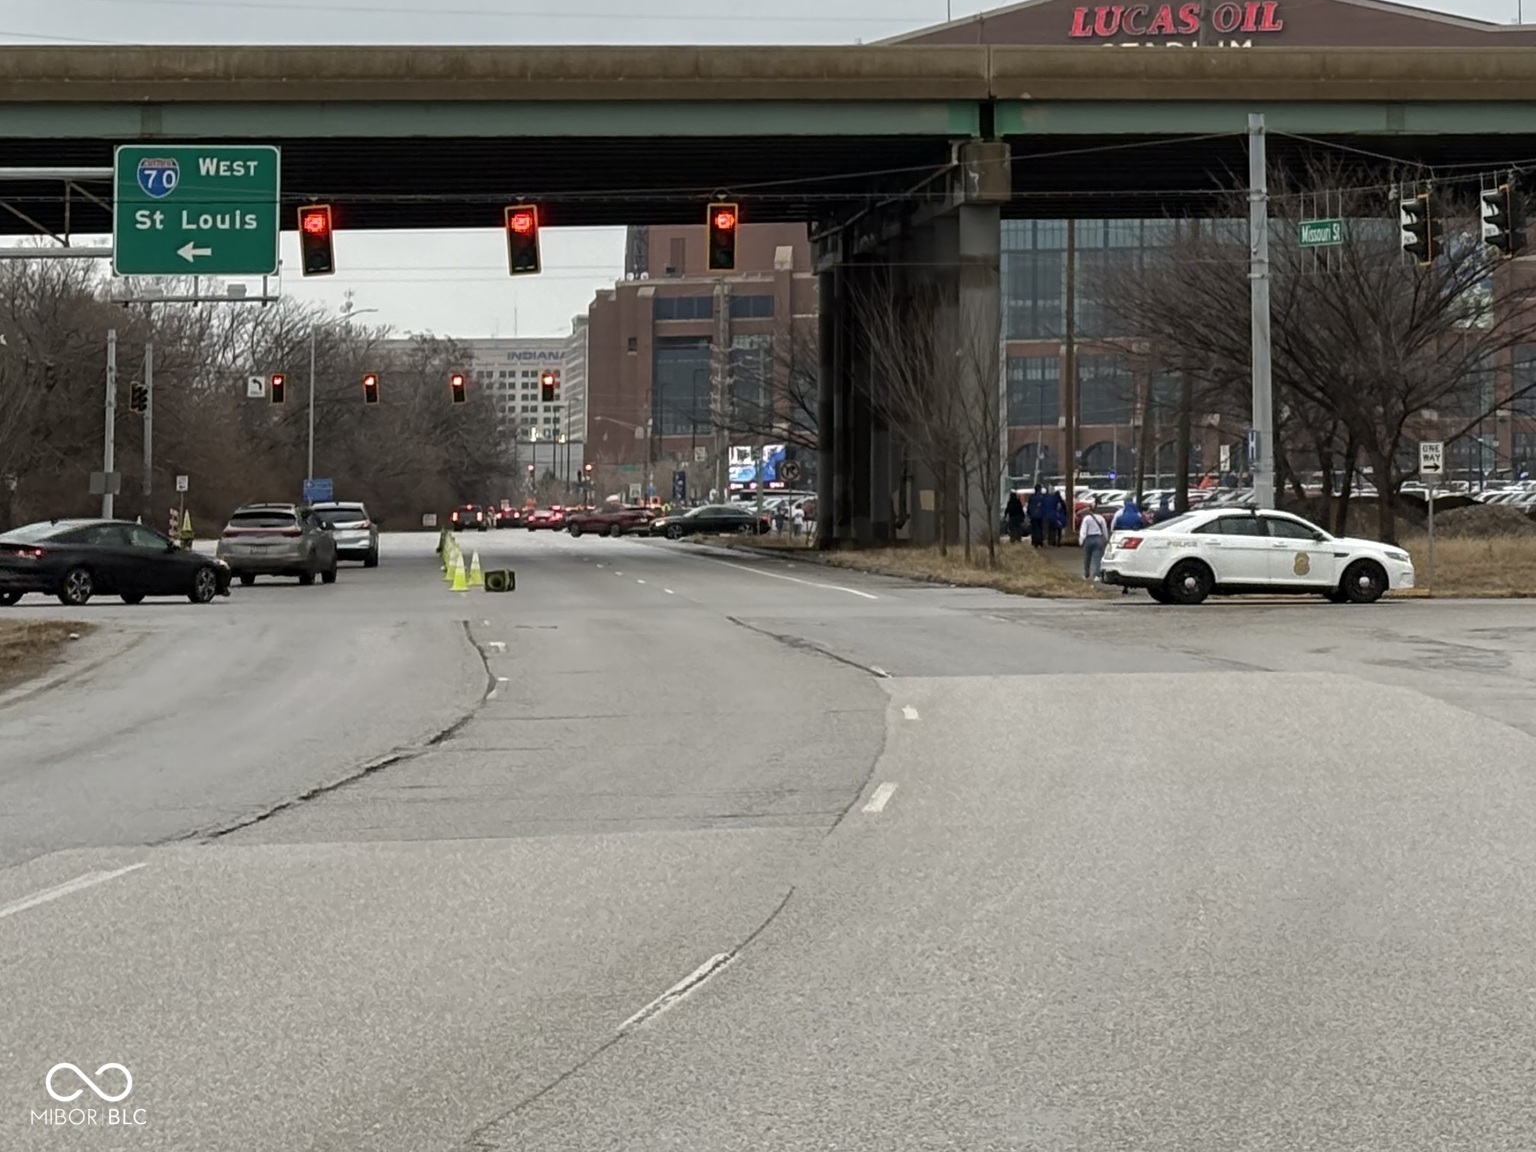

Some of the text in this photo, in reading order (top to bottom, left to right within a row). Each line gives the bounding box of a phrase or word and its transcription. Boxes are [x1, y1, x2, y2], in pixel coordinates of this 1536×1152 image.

[1069, 1, 1284, 37] LUCAS OIL
[198, 157, 258, 177] WEST
[143, 170, 177, 189] 70
[135, 209, 258, 230] St Louis
[1301, 223, 1341, 243] Missouri St
[1422, 444, 1441, 453] ONE
[1422, 453, 1441, 462] WAY
